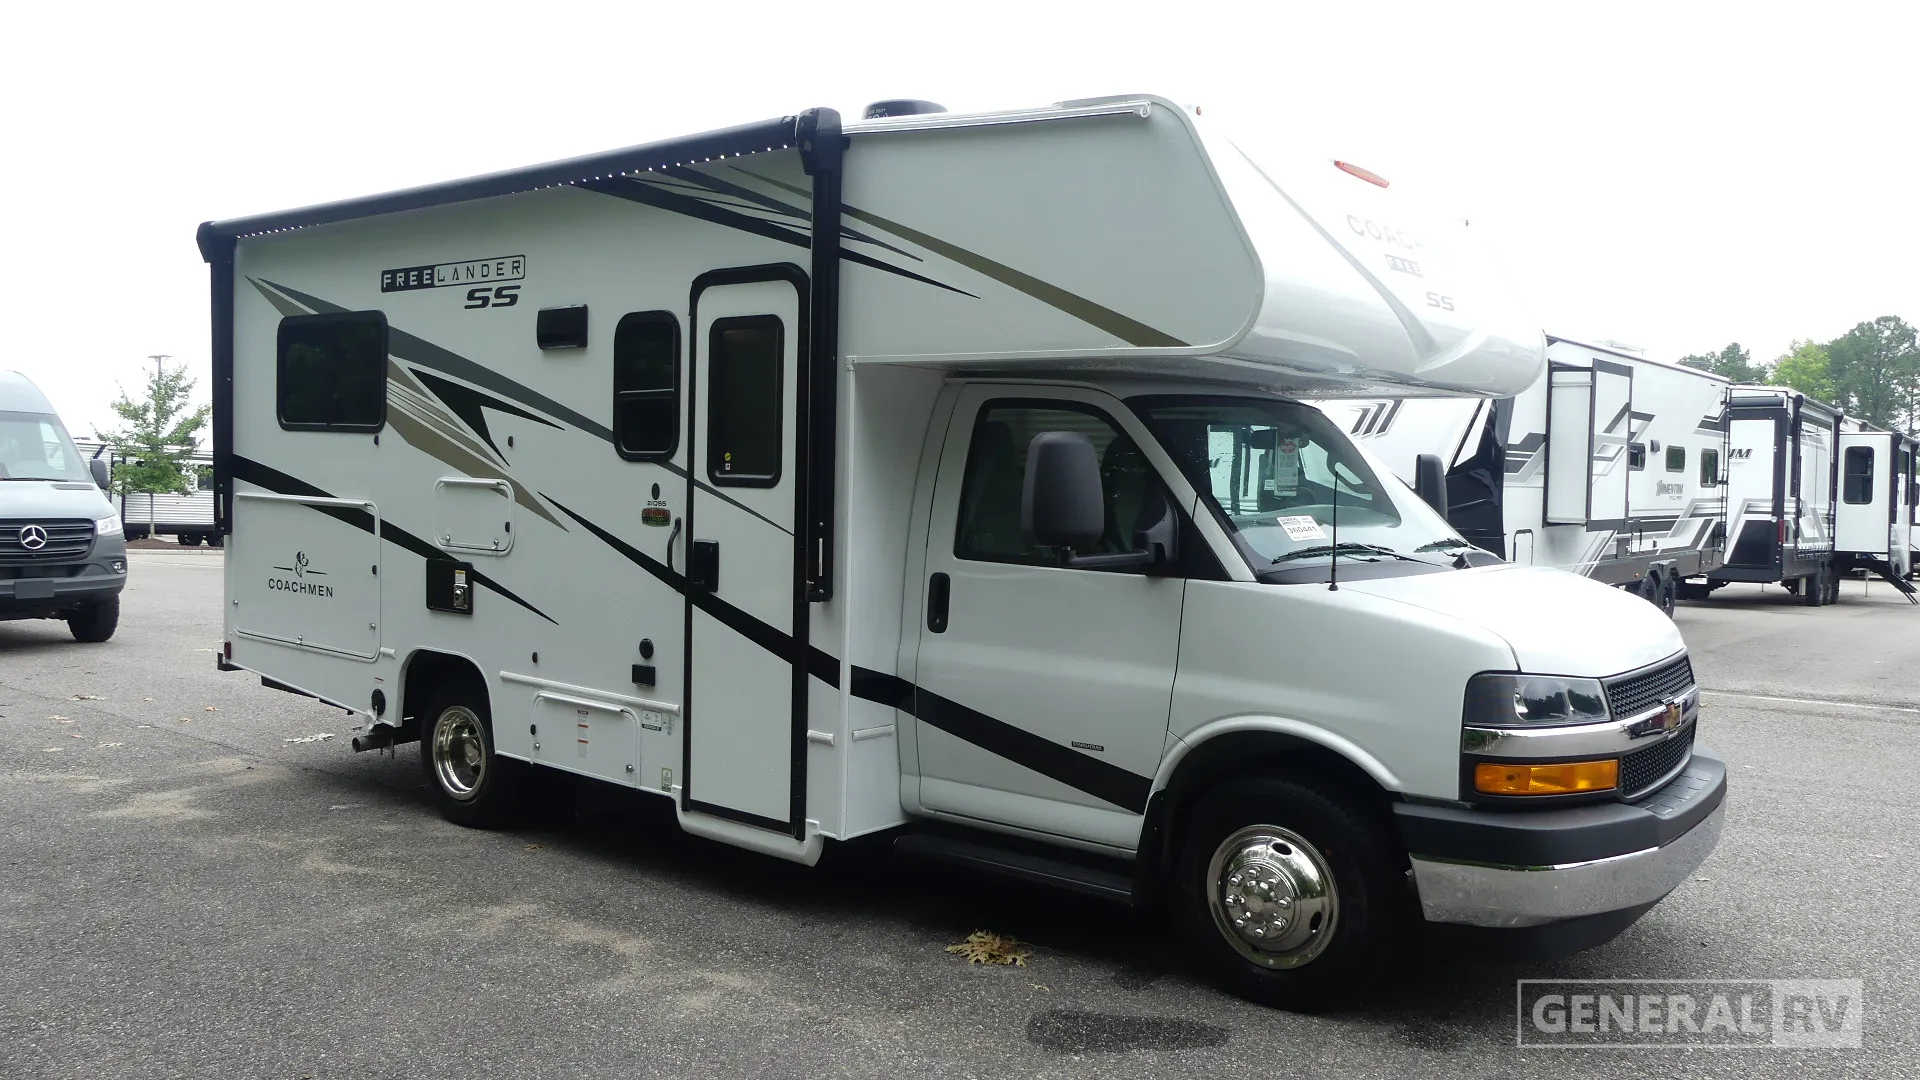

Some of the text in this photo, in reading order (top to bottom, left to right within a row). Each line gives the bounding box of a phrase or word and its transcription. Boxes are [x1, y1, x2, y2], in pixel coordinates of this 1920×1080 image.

[383, 260, 522, 289] FREELANDER
[464, 285, 521, 309] SS
[1425, 291, 1455, 312] SS
[268, 578, 333, 598] COACHMEN
